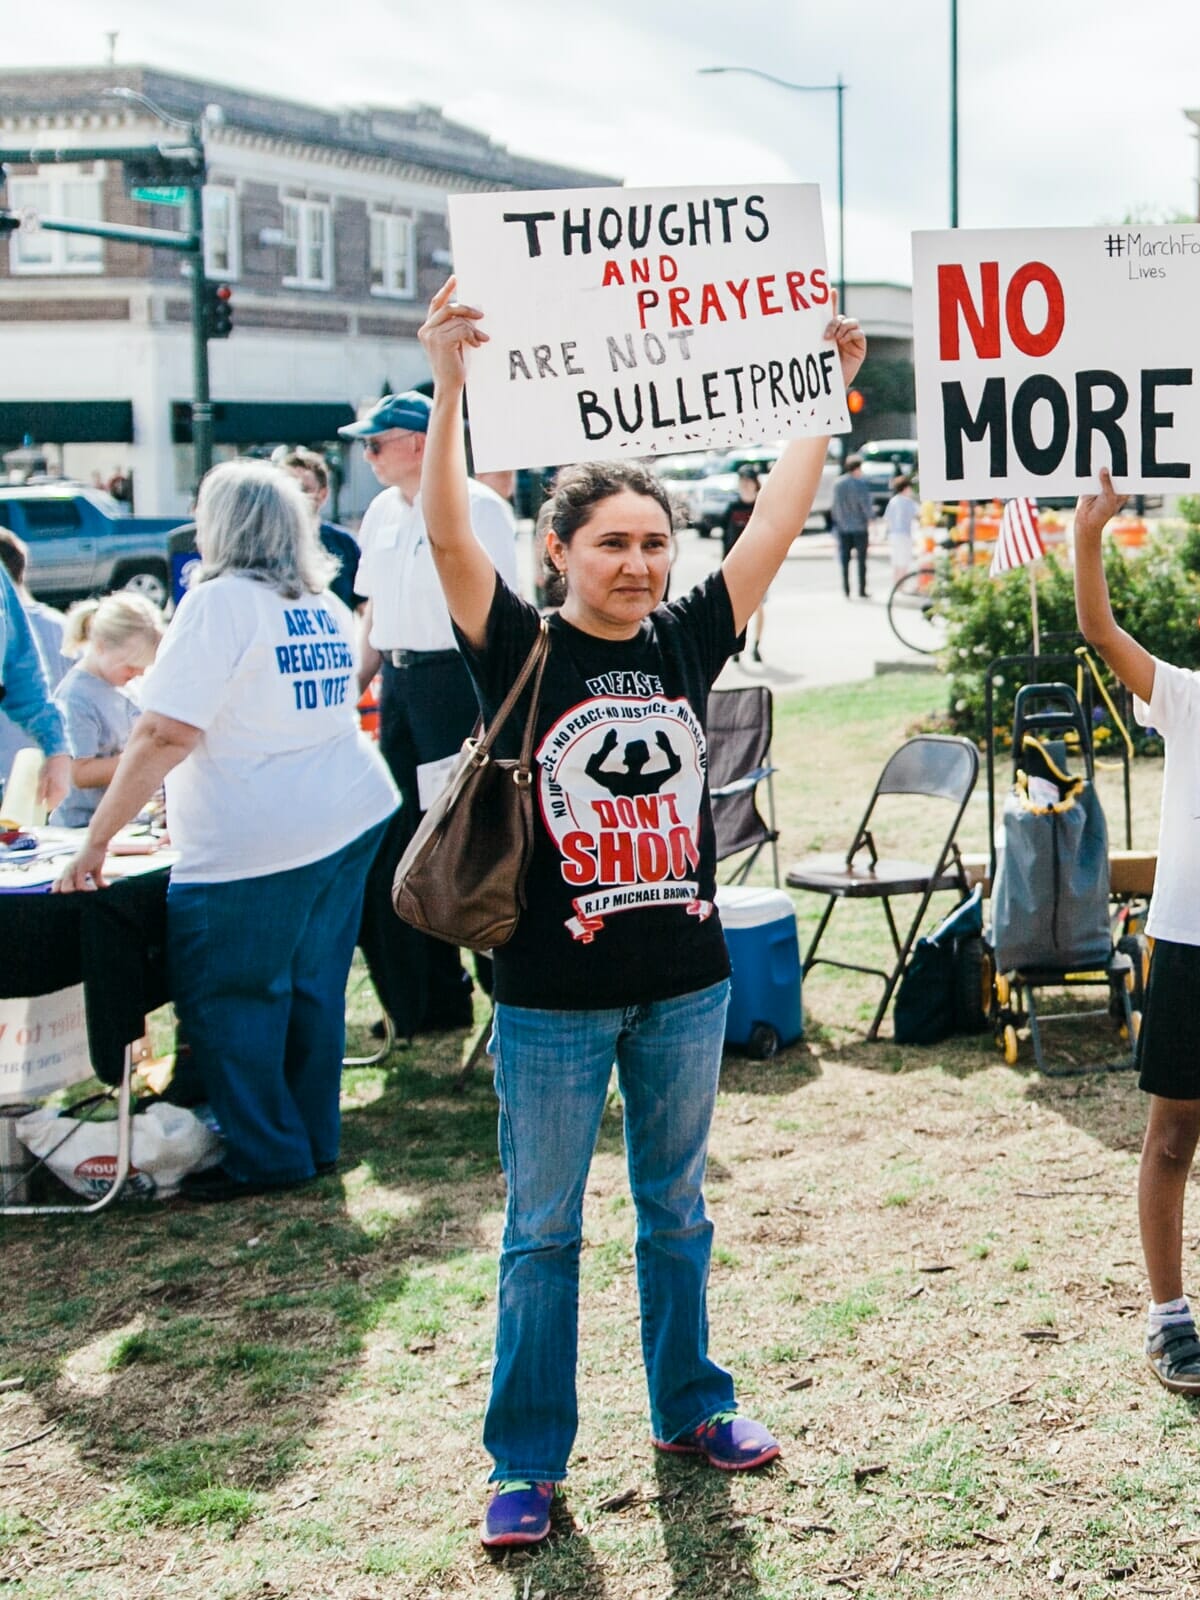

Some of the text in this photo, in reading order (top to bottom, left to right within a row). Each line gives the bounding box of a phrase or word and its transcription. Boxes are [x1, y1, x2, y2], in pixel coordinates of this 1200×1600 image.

[503, 195, 769, 258] THOUGHTS
[602, 254, 678, 287] AND
[1128, 260, 1166, 280] Lives
[637, 268, 829, 330] PRAYERS
[938, 261, 1065, 360] NO
[508, 329, 695, 381] ARE NOT
[577, 349, 836, 441] BULLETPROOF
[284, 608, 316, 636] ARE
[293, 674, 350, 709] TO VOTE
[586, 671, 664, 698] PLEASE
[566, 707, 603, 735] PEACE
[605, 706, 619, 718] NO
[622, 702, 667, 719] JUSTICE
[677, 706, 689, 722] NO
[553, 731, 571, 749] NO
[551, 800, 568, 818] NO
[591, 793, 681, 829] DON'T
[562, 826, 699, 884] SHOO
[612, 888, 662, 907] MICHAEL
